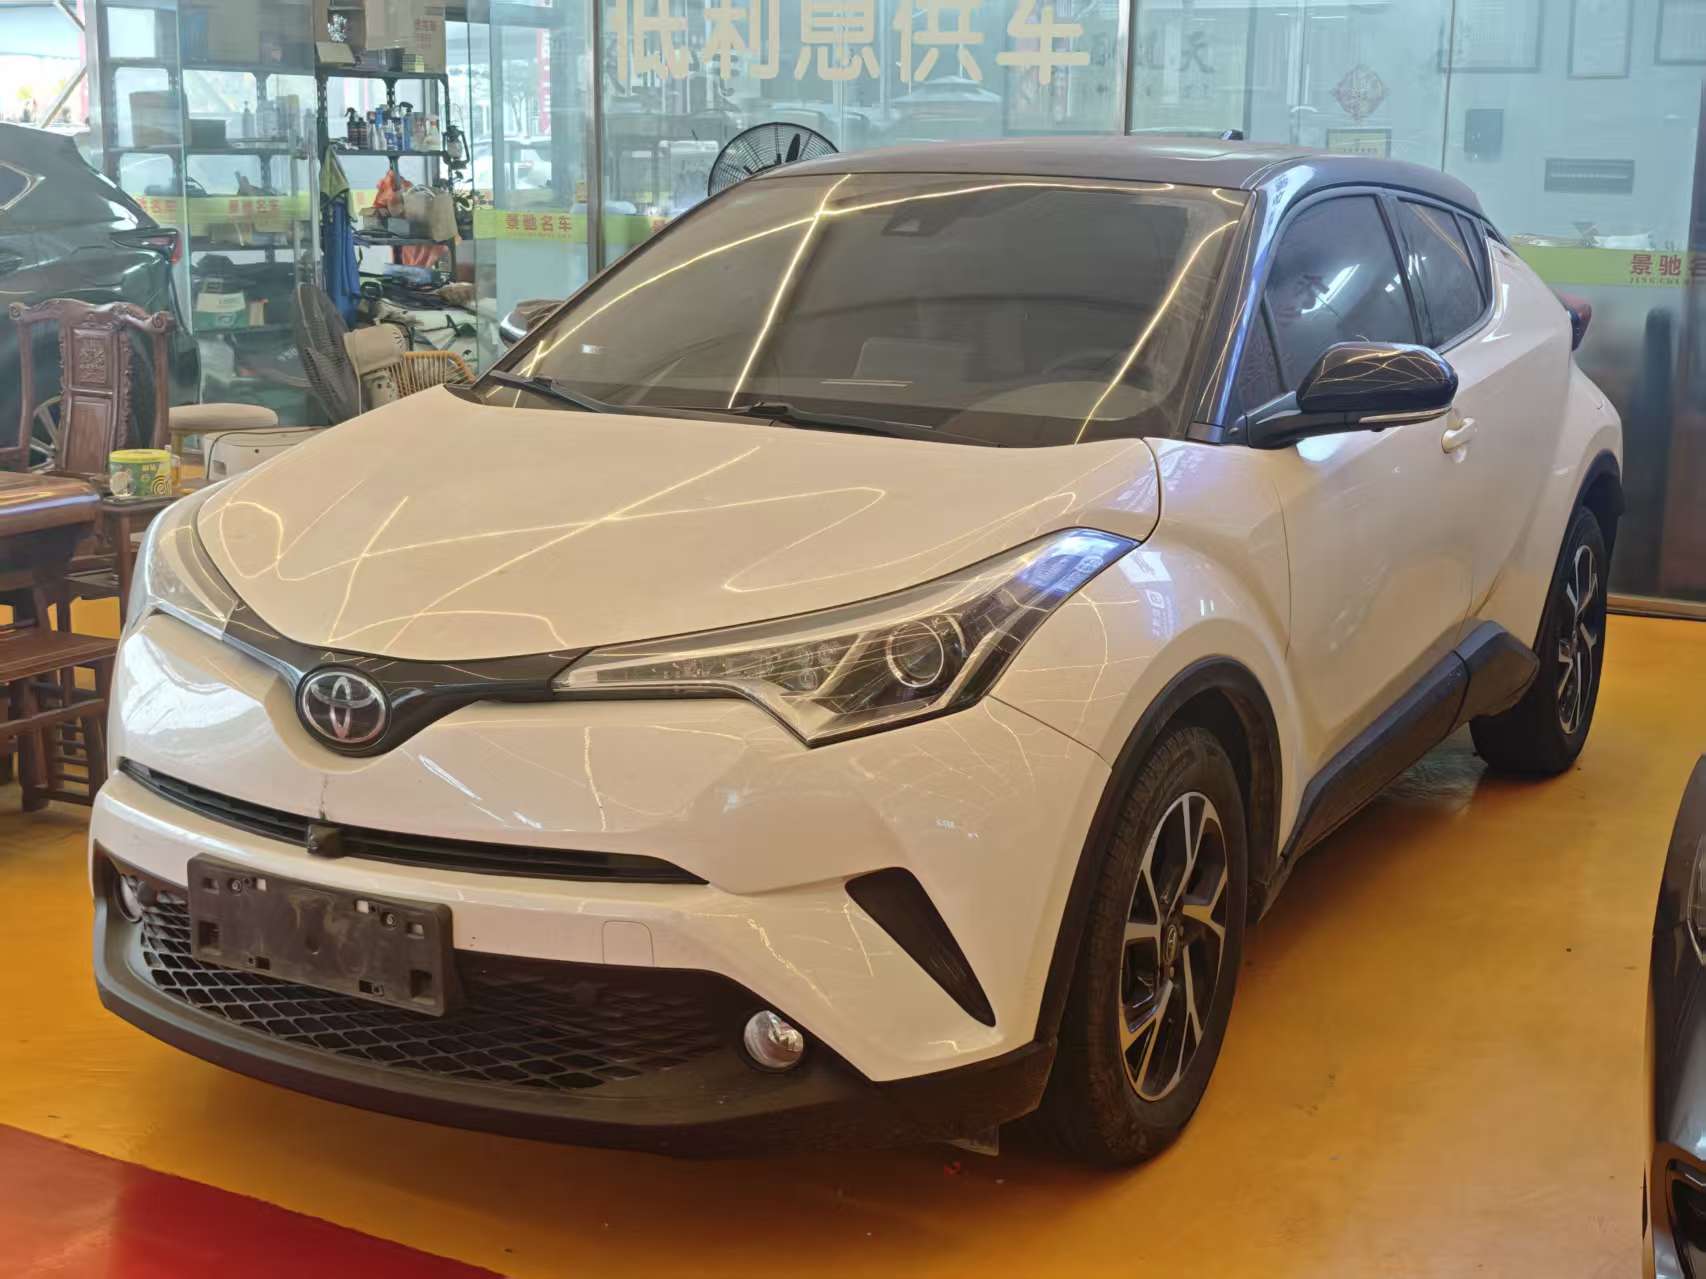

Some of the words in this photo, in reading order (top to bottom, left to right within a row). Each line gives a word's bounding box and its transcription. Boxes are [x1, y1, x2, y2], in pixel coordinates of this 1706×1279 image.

[610, 0, 1090, 85] 低利息供车
